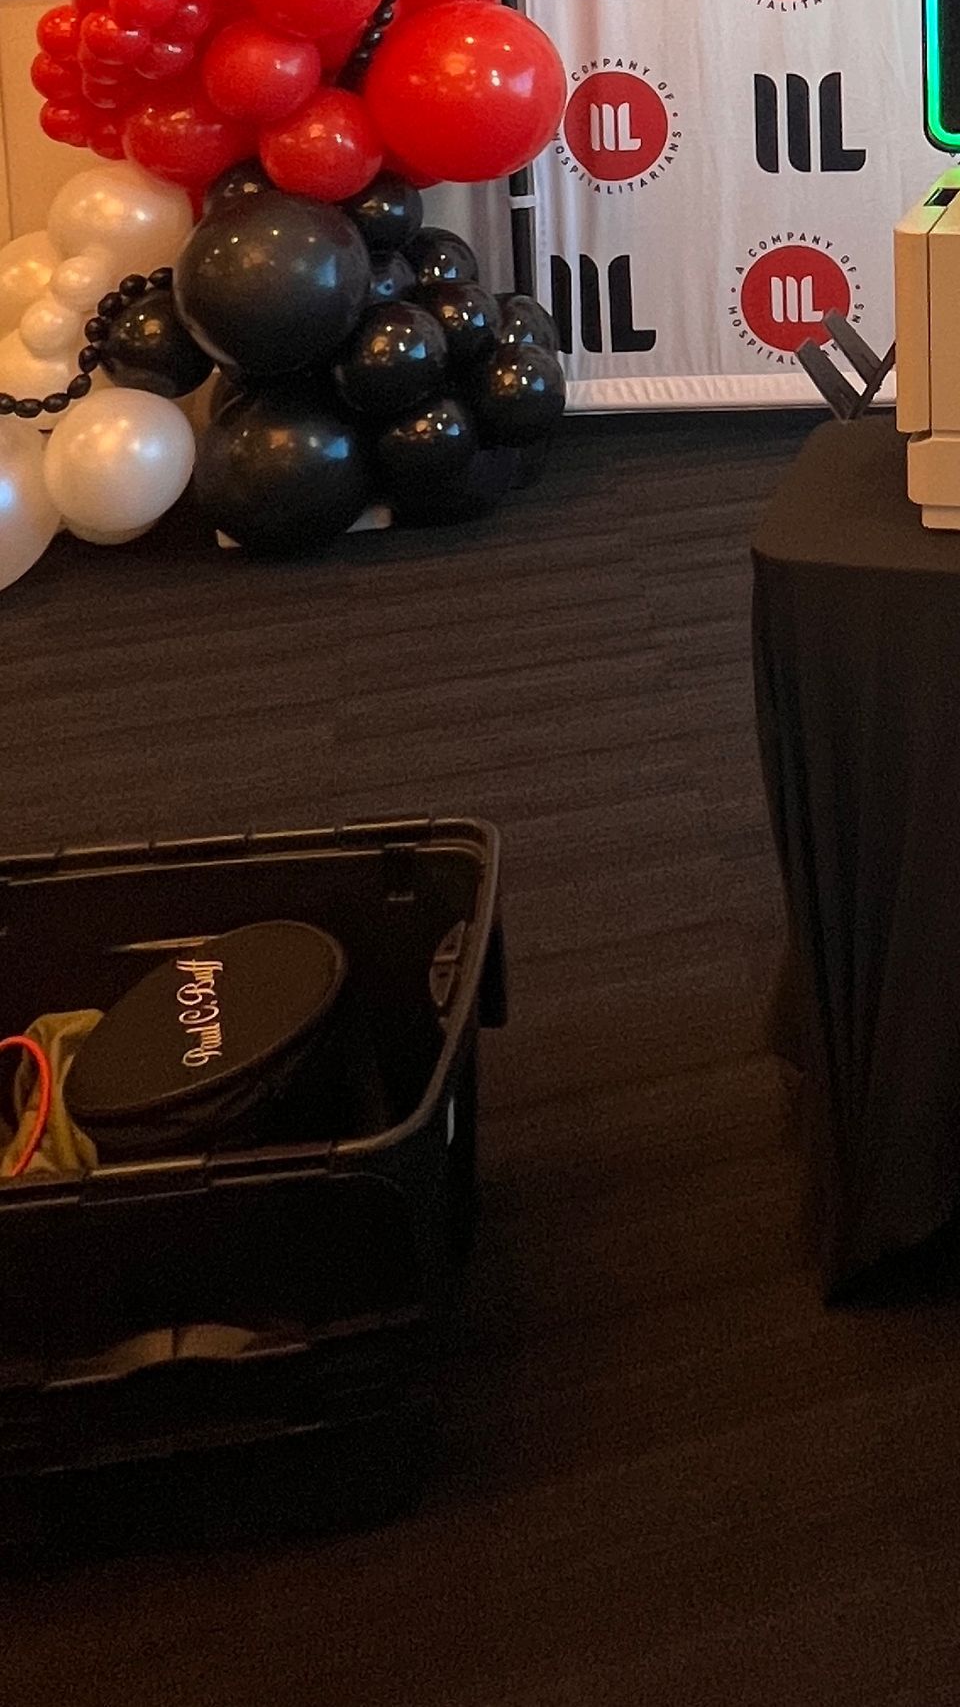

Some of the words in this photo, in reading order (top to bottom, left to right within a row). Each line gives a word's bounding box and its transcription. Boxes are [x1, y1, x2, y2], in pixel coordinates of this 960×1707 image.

[571, 58, 650, 81] COMPANY
[658, 82, 675, 101] OF
[735, 266, 745, 274] A
[748, 232, 833, 258] COMPANY
[840, 255, 857, 273] OF
[176, 959, 223, 1005] Buff
[182, 1022, 222, 1067] Paul
